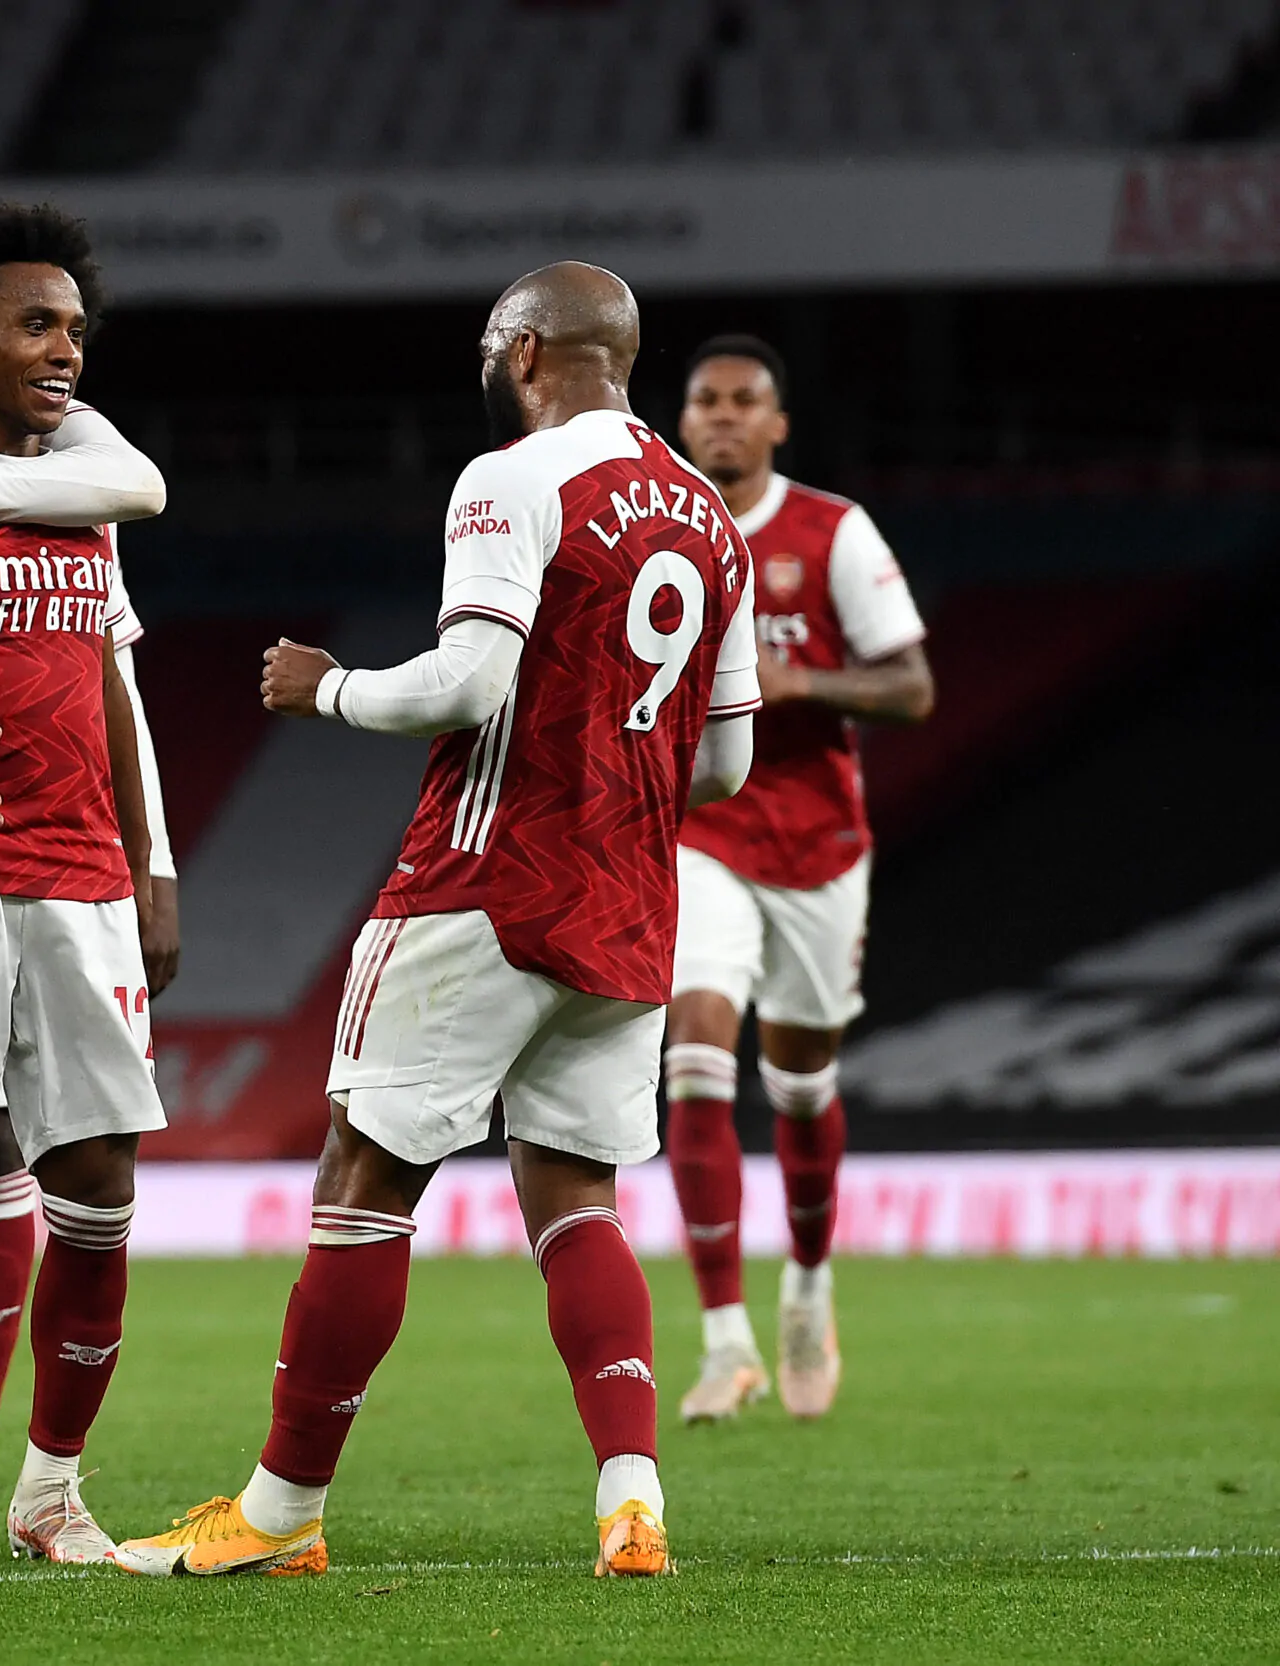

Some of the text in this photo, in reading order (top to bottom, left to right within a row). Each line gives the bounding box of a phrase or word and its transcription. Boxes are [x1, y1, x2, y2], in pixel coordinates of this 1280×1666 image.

[454, 500, 494, 522] VISIT
[45, 595, 108, 638] BETTE
[623, 550, 705, 732] 9
